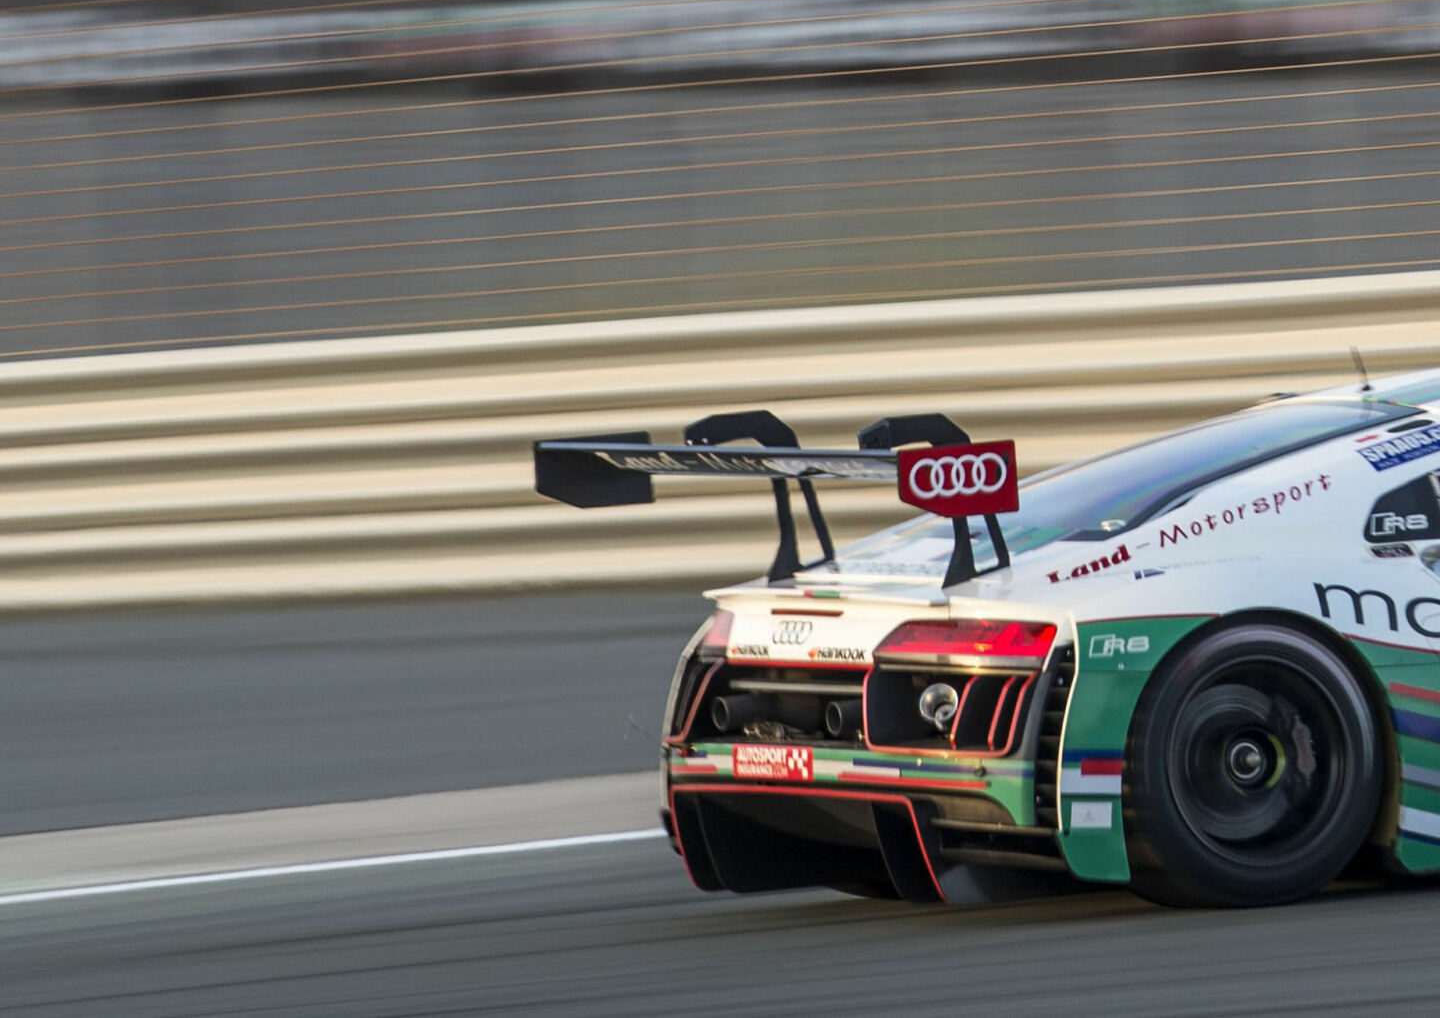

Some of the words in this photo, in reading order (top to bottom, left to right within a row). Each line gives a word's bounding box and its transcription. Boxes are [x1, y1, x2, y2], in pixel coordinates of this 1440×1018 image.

[1046, 544, 1131, 584] Land
[1159, 473, 1332, 548] Motorsport
[1383, 514, 1430, 531] R8
[1103, 636, 1150, 655] R8
[737, 746, 787, 764] AUTOSPORT
